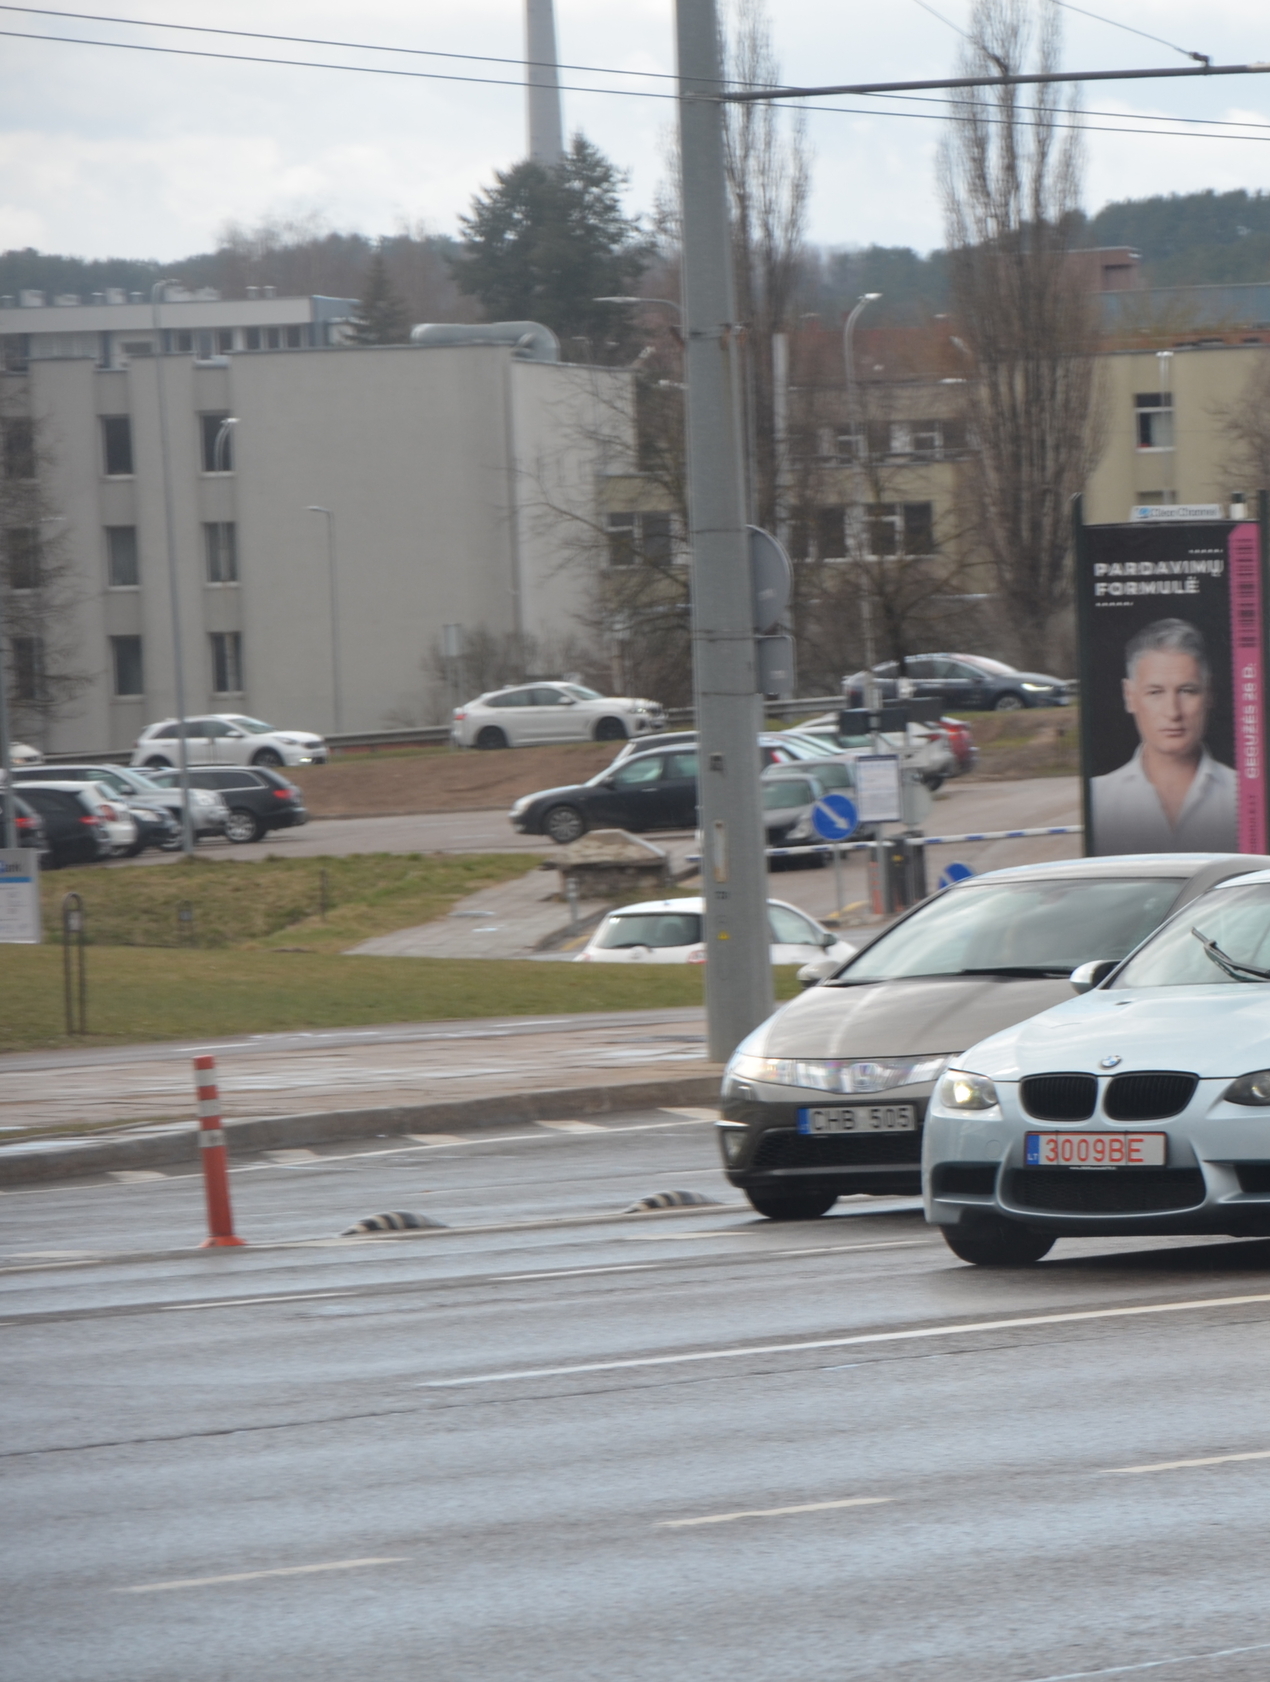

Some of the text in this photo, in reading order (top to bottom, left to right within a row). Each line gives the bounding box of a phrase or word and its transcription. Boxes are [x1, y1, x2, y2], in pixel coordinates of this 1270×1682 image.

[1095, 576, 1200, 596] FORMULĖ
[870, 1107, 909, 1128] 505
[1027, 1138, 1144, 1162] LT 3009BE
